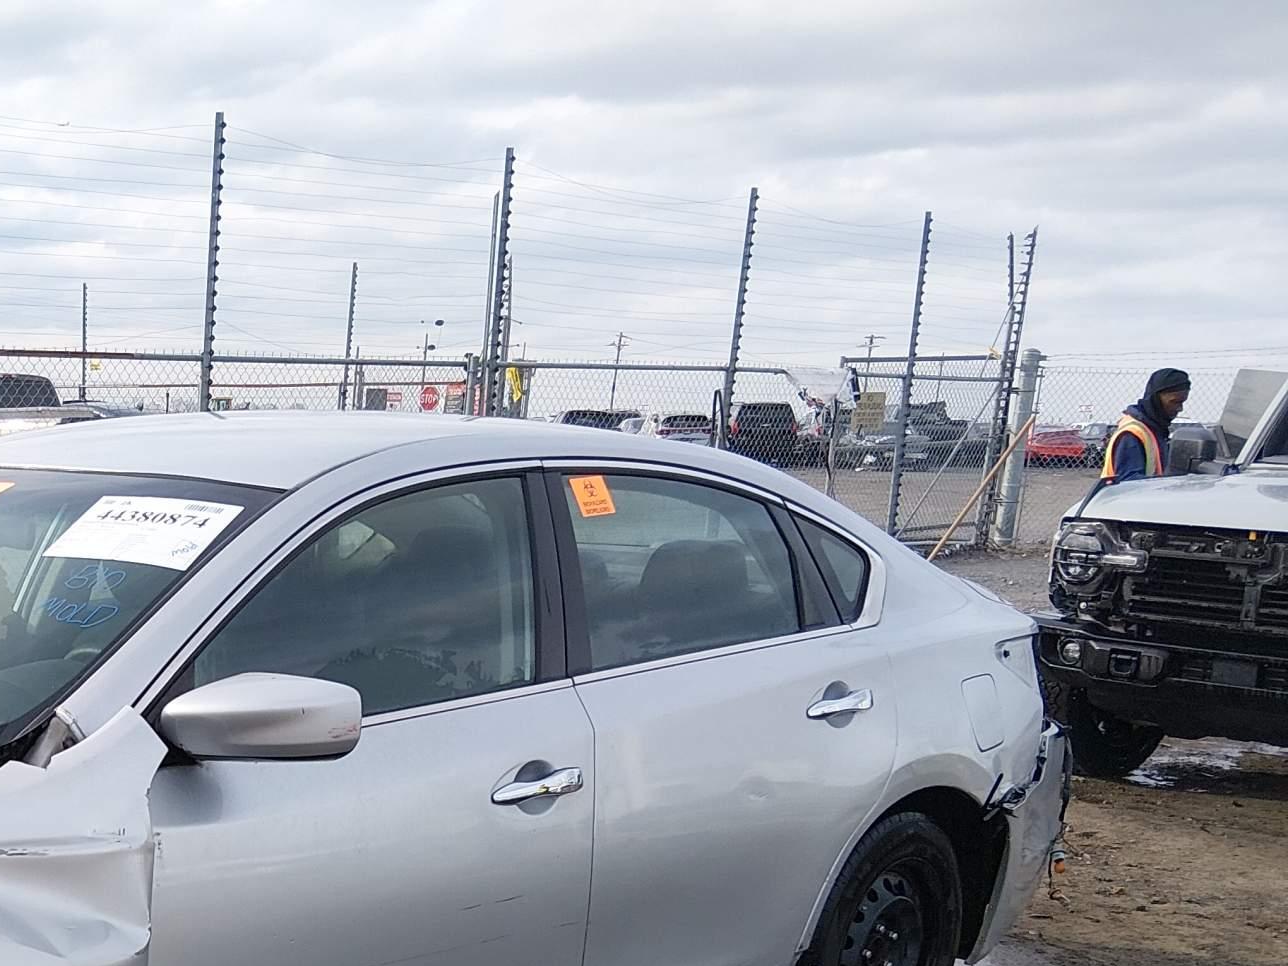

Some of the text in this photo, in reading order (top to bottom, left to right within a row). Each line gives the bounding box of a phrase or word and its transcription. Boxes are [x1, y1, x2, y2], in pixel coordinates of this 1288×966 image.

[420, 394, 439, 404] STOP
[96, 509, 212, 529] 44380874
[47, 597, 120, 628] MOLD
